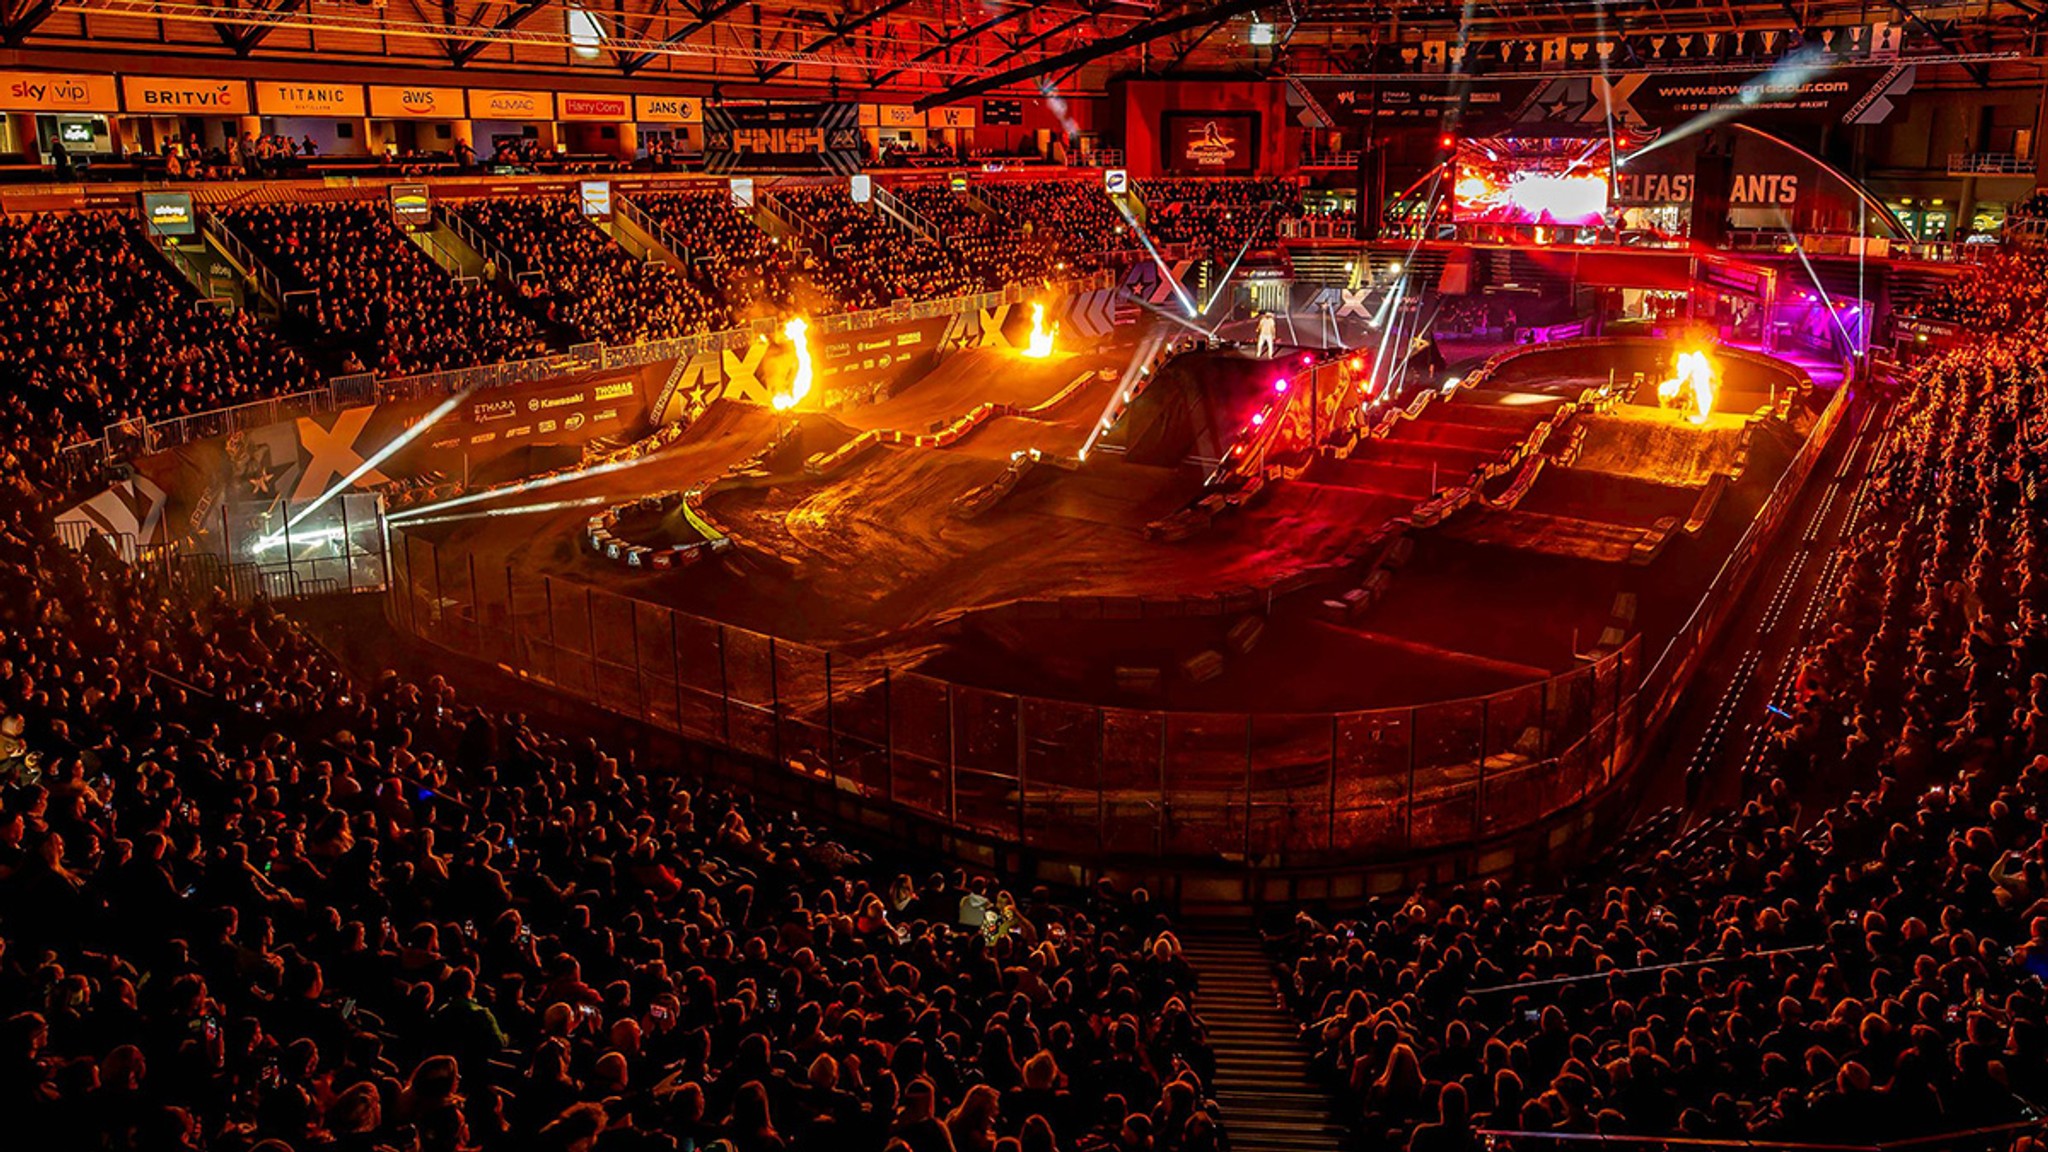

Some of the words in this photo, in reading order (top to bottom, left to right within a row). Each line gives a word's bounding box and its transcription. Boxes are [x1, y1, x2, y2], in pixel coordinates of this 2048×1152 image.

[11, 81, 46, 101] sky
[54, 80, 84, 100] vip
[144, 89, 231, 105] BRITVIC
[278, 87, 344, 102] TITANIC
[402, 90, 434, 104] aws
[490, 99, 534, 110] ALMAC
[567, 100, 595, 113] Harry
[596, 100, 623, 113] Corry
[648, 102, 677, 114] JANS
[474, 400, 516, 414] ETHARA
[541, 393, 585, 409] Kawasaki
